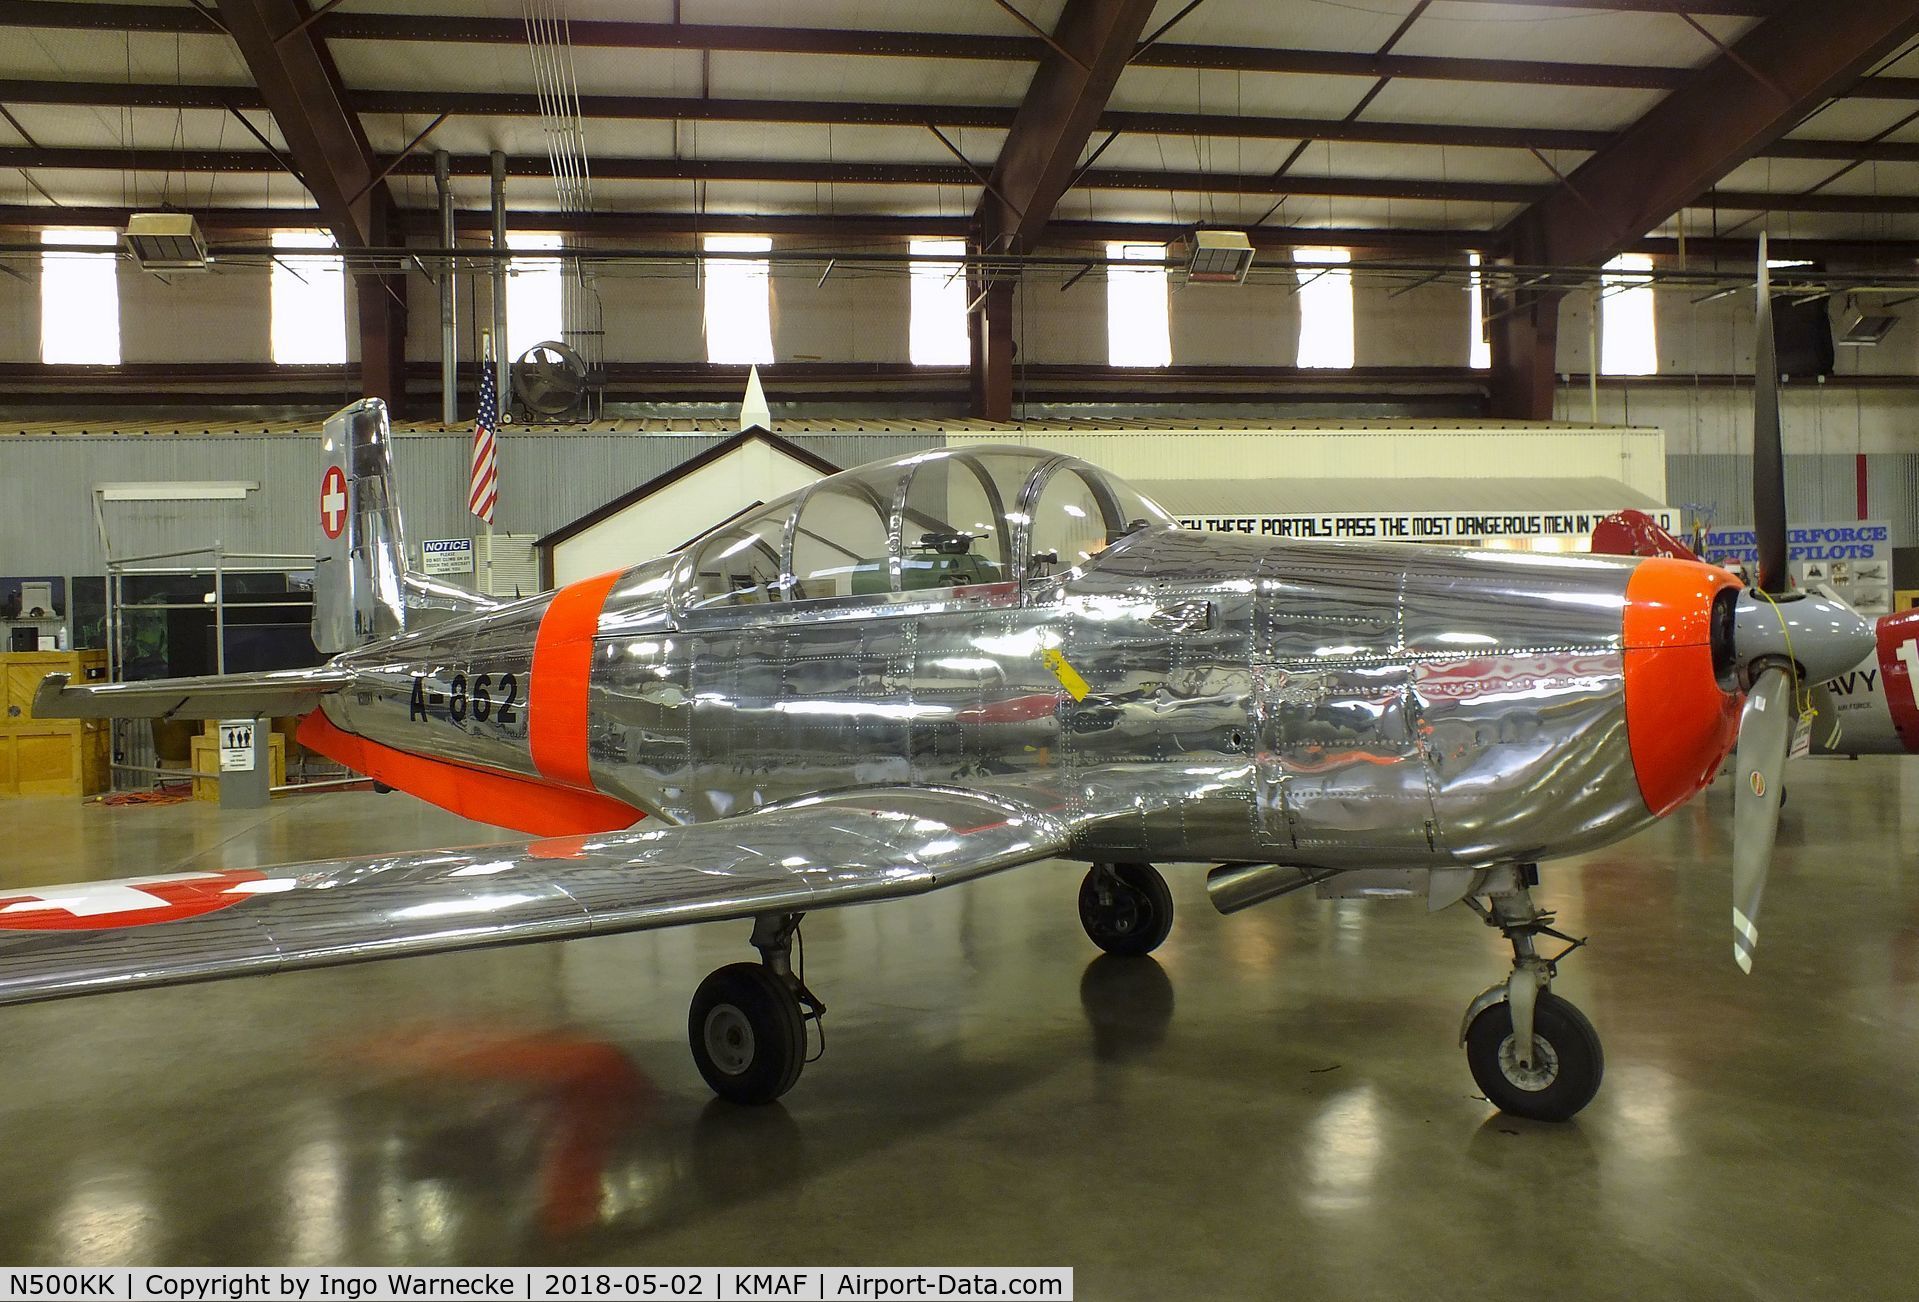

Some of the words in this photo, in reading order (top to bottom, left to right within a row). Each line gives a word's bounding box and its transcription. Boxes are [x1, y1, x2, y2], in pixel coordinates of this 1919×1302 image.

[1261, 518, 1332, 537] PORTALS
[1336, 518, 1376, 536] PASS
[1380, 517, 1409, 536] THE
[1412, 517, 1452, 535] MOST
[1456, 516, 1540, 535] DANGEROUS
[1544, 516, 1573, 534] MEN
[1576, 515, 1589, 533] IN
[425, 541, 469, 551] NOTICE
[1789, 544, 1874, 561] PILOTS
[410, 673, 517, 723] A-862
